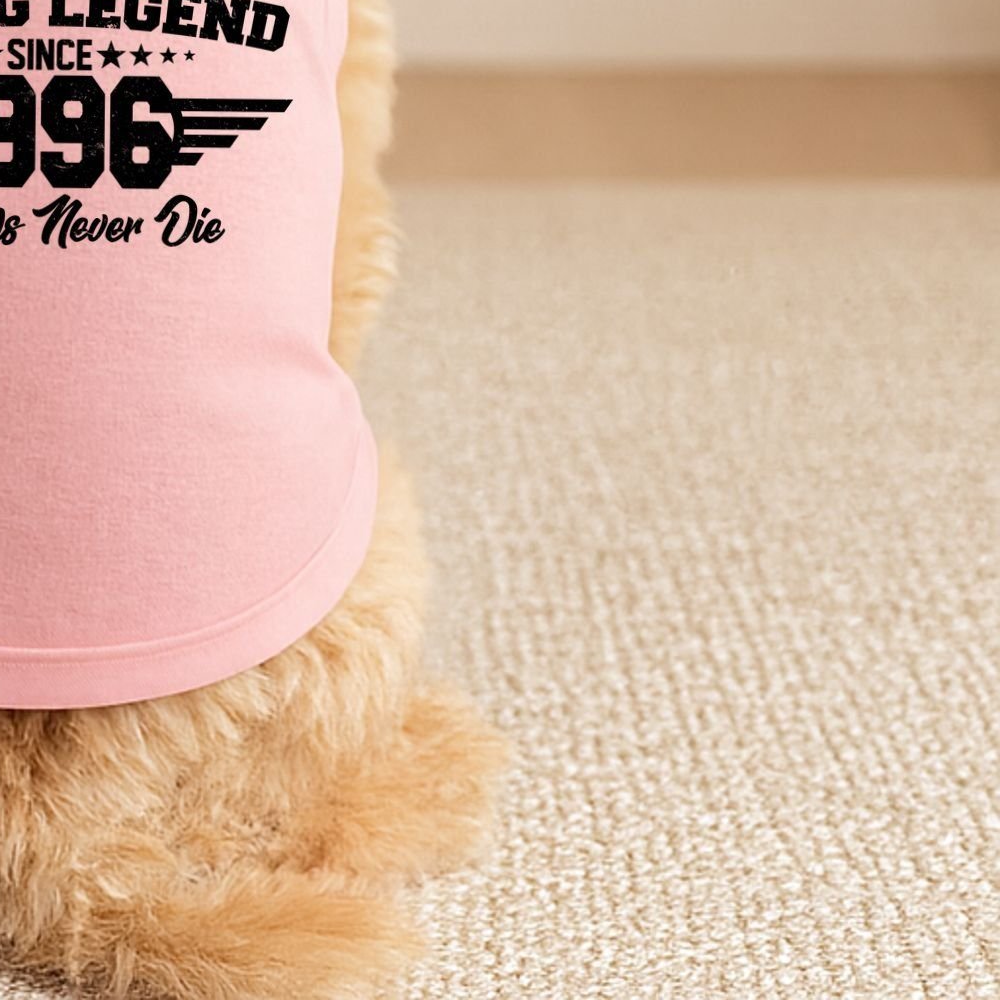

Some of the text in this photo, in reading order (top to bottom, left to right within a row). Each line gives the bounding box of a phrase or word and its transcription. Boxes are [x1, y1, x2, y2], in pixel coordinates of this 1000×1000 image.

[7, 38, 93, 71] SINCE
[32, 194, 144, 250] Never
[154, 194, 226, 248] Die
